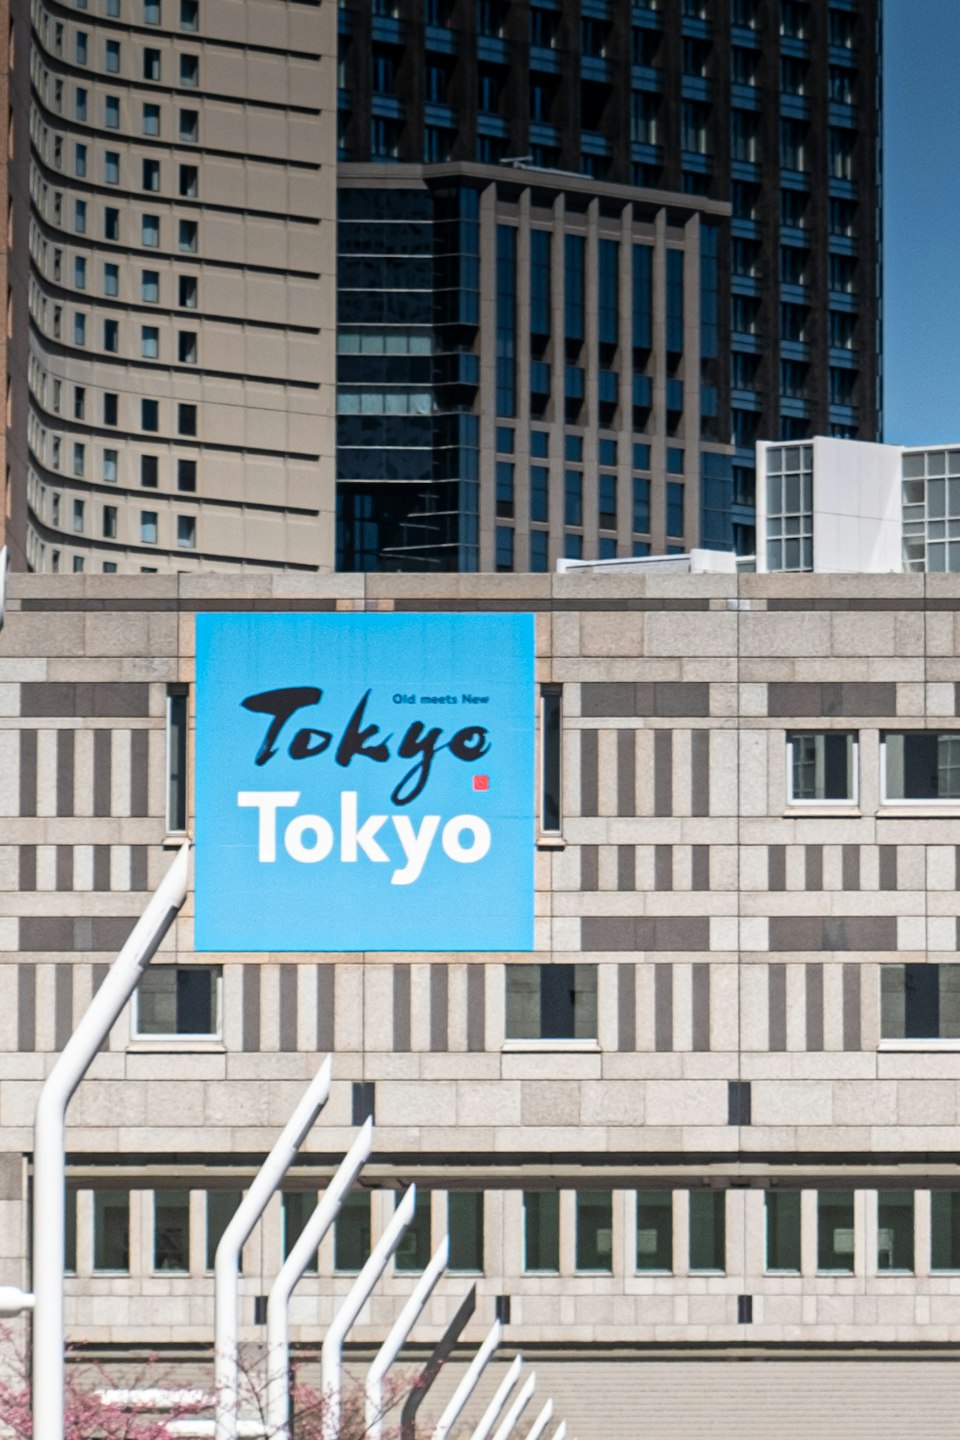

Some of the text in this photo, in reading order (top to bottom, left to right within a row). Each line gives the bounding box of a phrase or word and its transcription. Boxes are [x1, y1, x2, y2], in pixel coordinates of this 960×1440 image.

[392, 693, 489, 704] Old meets New
[240, 686, 492, 806] Tokyo
[237, 791, 492, 885] Tokyo
